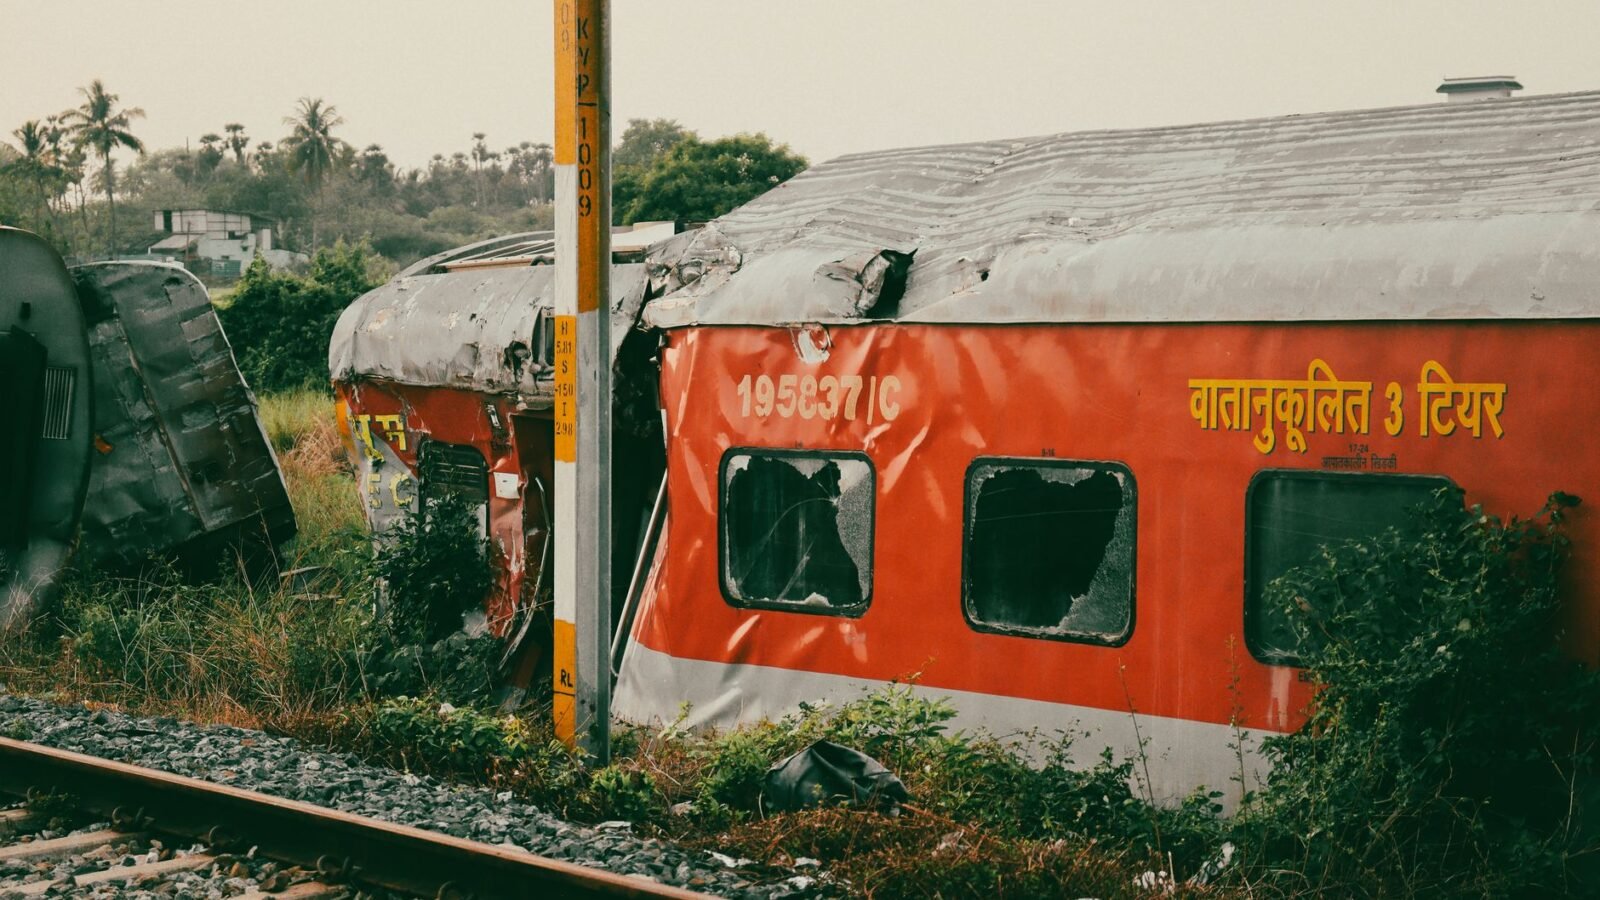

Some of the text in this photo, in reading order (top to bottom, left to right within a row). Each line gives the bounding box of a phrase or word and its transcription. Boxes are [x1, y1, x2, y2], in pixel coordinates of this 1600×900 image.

[562, 360, 568, 374] S
[1188, 358, 1507, 455] वातानुकूलित 3 टियर
[560, 669, 573, 687] RL
